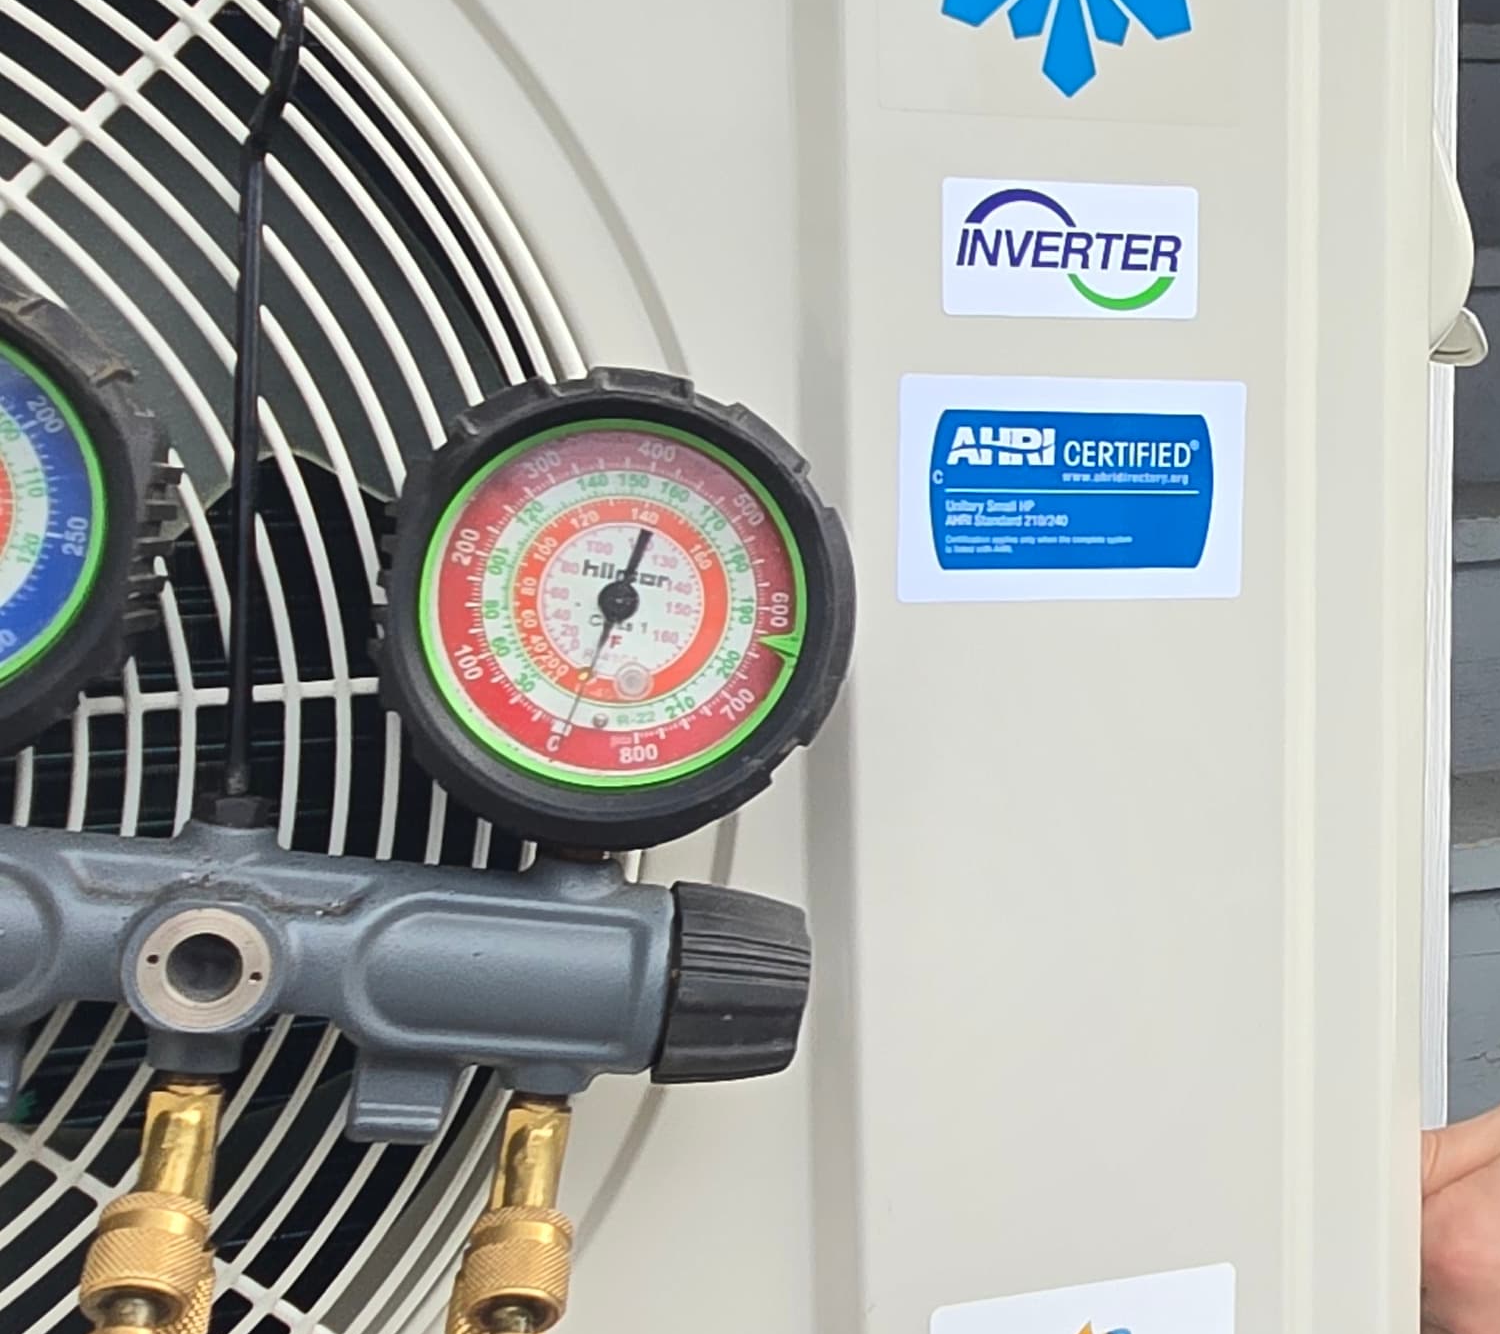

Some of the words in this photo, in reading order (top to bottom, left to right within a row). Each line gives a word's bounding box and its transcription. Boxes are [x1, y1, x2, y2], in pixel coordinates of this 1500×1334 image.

[955, 225, 1183, 274] INVERTER
[26, 394, 65, 434] 200
[637, 440, 677, 463] 400
[946, 425, 1057, 467] AHRI
[523, 450, 562, 480] 300
[576, 473, 609, 491] 140
[618, 473, 650, 490] 150
[660, 480, 691, 503] 160
[1061, 472, 1189, 486] www.ahridirectory.org
[514, 500, 546, 527] 120
[569, 510, 601, 530] 120
[631, 507, 661, 525] 140
[699, 503, 728, 533] 170
[733, 491, 766, 527] 500
[944, 499, 985, 517] Unitary
[986, 499, 1018, 512] Small
[1018, 499, 1036, 512] HP
[944, 514, 973, 527] AHRI
[973, 514, 1023, 528] Standard
[61, 516, 89, 557] 250
[451, 527, 481, 567] 200
[532, 536, 559, 563] 100
[487, 546, 511, 577] 100
[688, 543, 714, 572] 160
[520, 576, 539, 597] 80
[520, 608, 539, 629] 60
[770, 591, 790, 628] 600
[453, 644, 485, 682] 100
[716, 649, 741, 679] 200
[664, 695, 696, 720] 210
[719, 687, 756, 722] 700
[618, 743, 659, 764] 800
